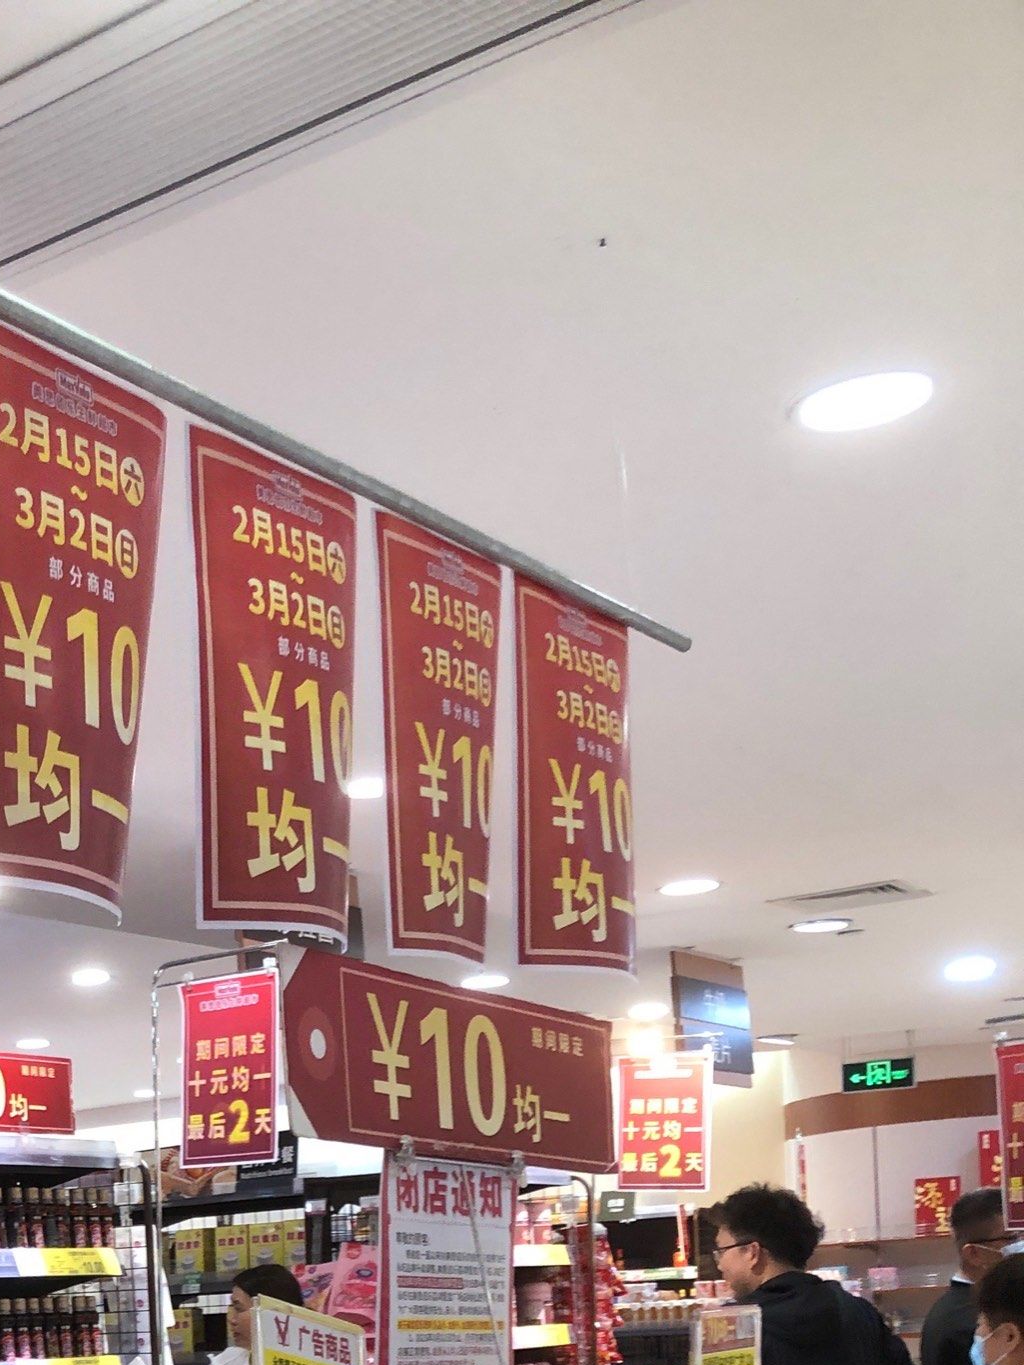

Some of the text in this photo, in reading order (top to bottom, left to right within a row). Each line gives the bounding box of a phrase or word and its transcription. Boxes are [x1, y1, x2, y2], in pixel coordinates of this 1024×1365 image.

[4, 724, 129, 850] 均一
[246, 786, 349, 893] 均一
[196, 1033, 266, 1061] 期间限定
[189, 1066, 273, 1097] 十元均一
[366, 993, 572, 1143] ¥10 均一
[9, 1093, 47, 1121] 均一
[187, 1099, 272, 1145] 最后2天
[621, 1144, 704, 1178] 最后2天
